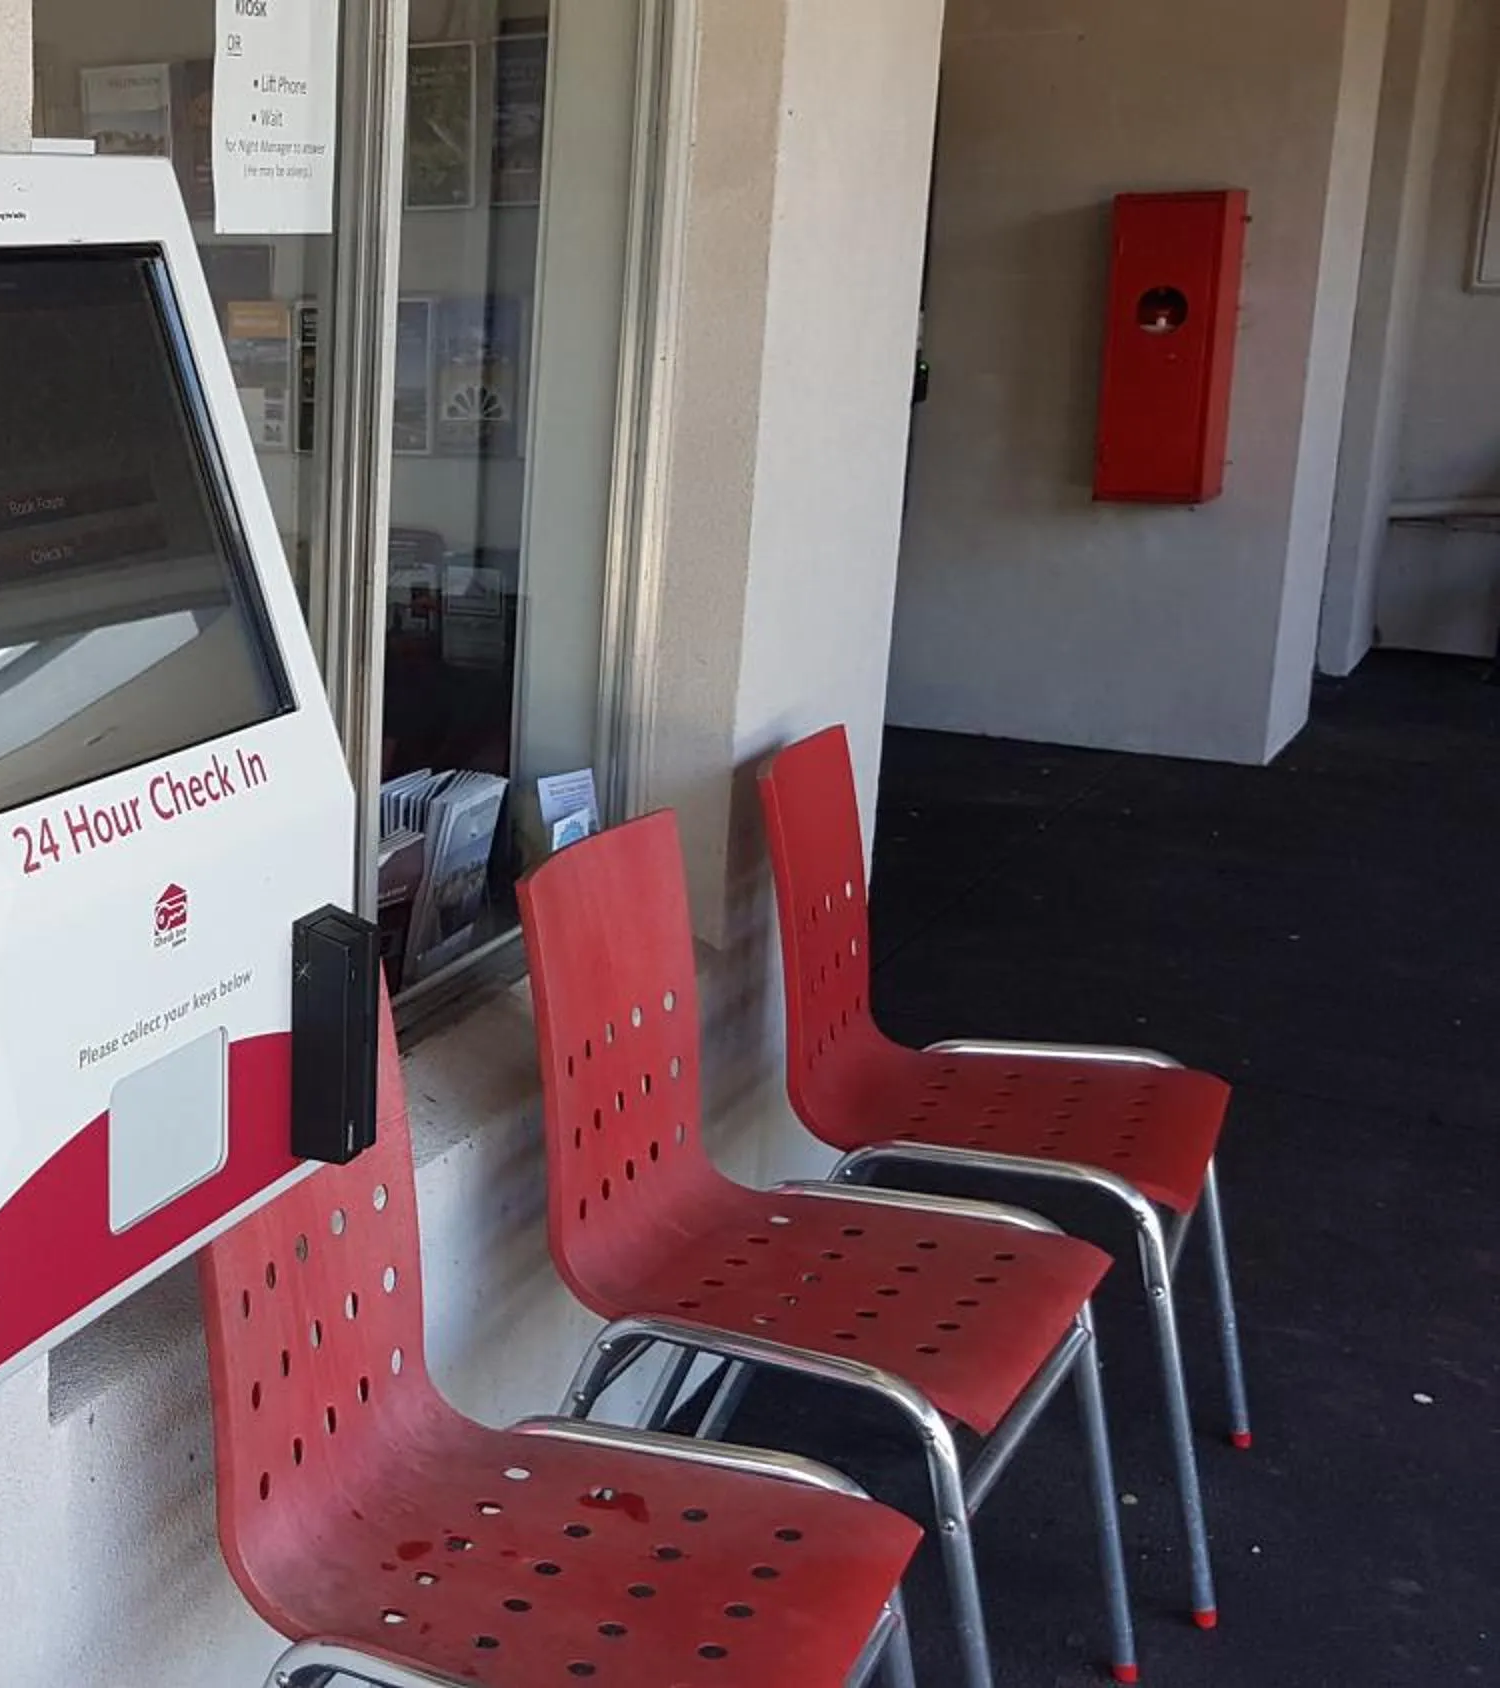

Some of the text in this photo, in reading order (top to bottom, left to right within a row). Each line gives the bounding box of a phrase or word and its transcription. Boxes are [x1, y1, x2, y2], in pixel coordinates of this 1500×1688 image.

[227, 33, 242, 55] OR
[261, 73, 307, 95] Lift Phone
[260, 108, 283, 127] Wait
[238, 139, 258, 156] Night
[260, 140, 292, 156] Manager
[13, 748, 267, 874] 24 Hour Check In
[78, 968, 252, 1069] Please collect your keys below
